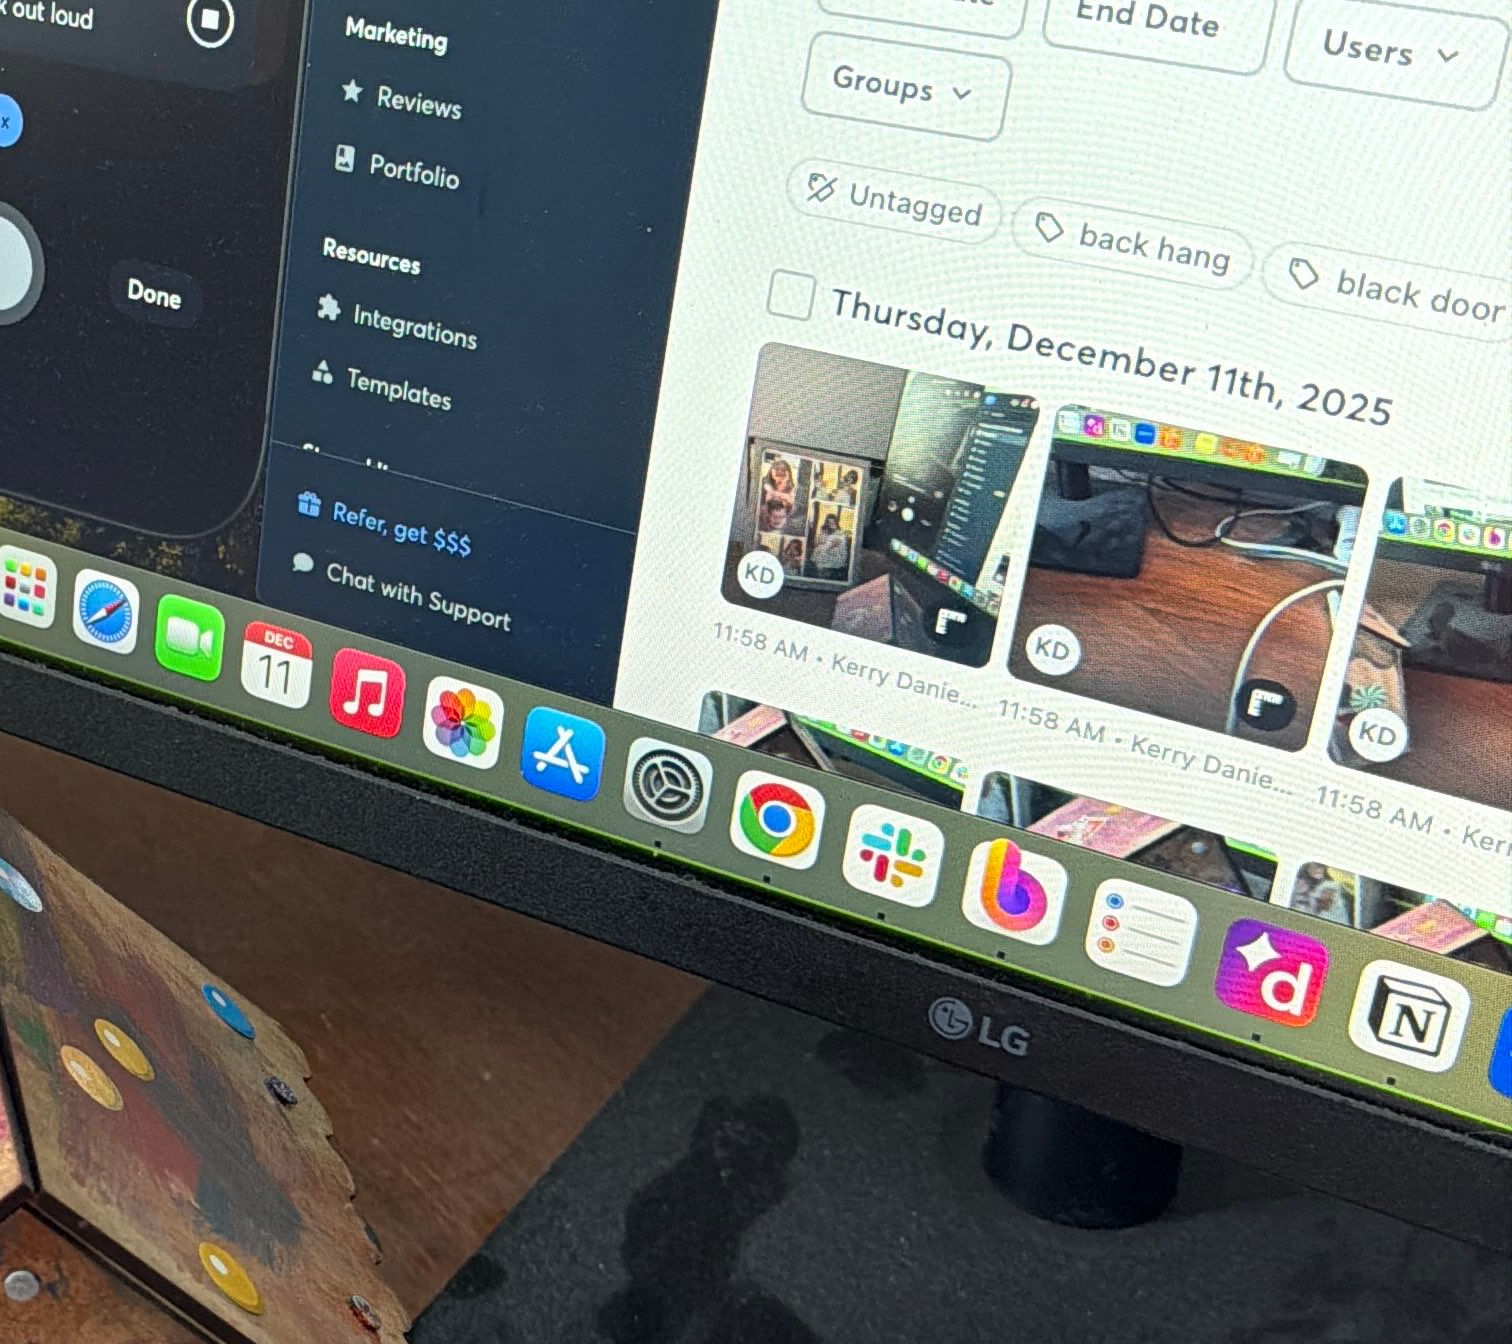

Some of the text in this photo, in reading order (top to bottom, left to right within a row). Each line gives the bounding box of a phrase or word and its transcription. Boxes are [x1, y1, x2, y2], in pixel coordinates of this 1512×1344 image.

[12, 0, 45, 22] out
[50, 2, 94, 30] loud
[345, 15, 448, 56] Marketing
[1145, 3, 1221, 39] Date
[1322, 28, 1414, 67] Users
[377, 84, 463, 121] Reviews
[832, 64, 934, 104] Groups
[370, 153, 460, 191] Portfolio
[849, 181, 984, 229] Untagged
[322, 236, 422, 276] Resources
[1079, 222, 1232, 277] back hang
[128, 277, 182, 310] Done
[1337, 268, 1507, 324] black door
[353, 303, 478, 351] Integrations
[832, 287, 1394, 428] Thursday, December 11th, 2025
[347, 366, 452, 412] Templates
[333, 500, 472, 559] Refer, get $$$
[744, 563, 775, 586] KD
[327, 563, 512, 633] Chat with Support
[264, 629, 294, 650] DEC
[713, 621, 768, 651] 11:58
[773, 638, 808, 663] AM
[831, 653, 889, 686] Kerry
[1034, 637, 1071, 662] KD
[258, 653, 291, 696] 11
[998, 699, 1059, 730] 11:58
[1065, 717, 1107, 744] AM
[1131, 734, 1193, 770] Kerry
[1358, 720, 1397, 747] KD
[1317, 785, 1383, 820] 11:58
[1389, 807, 1434, 834] AM
[979, 1016, 1032, 1056] LG
[1388, 1002, 1437, 1044] N
